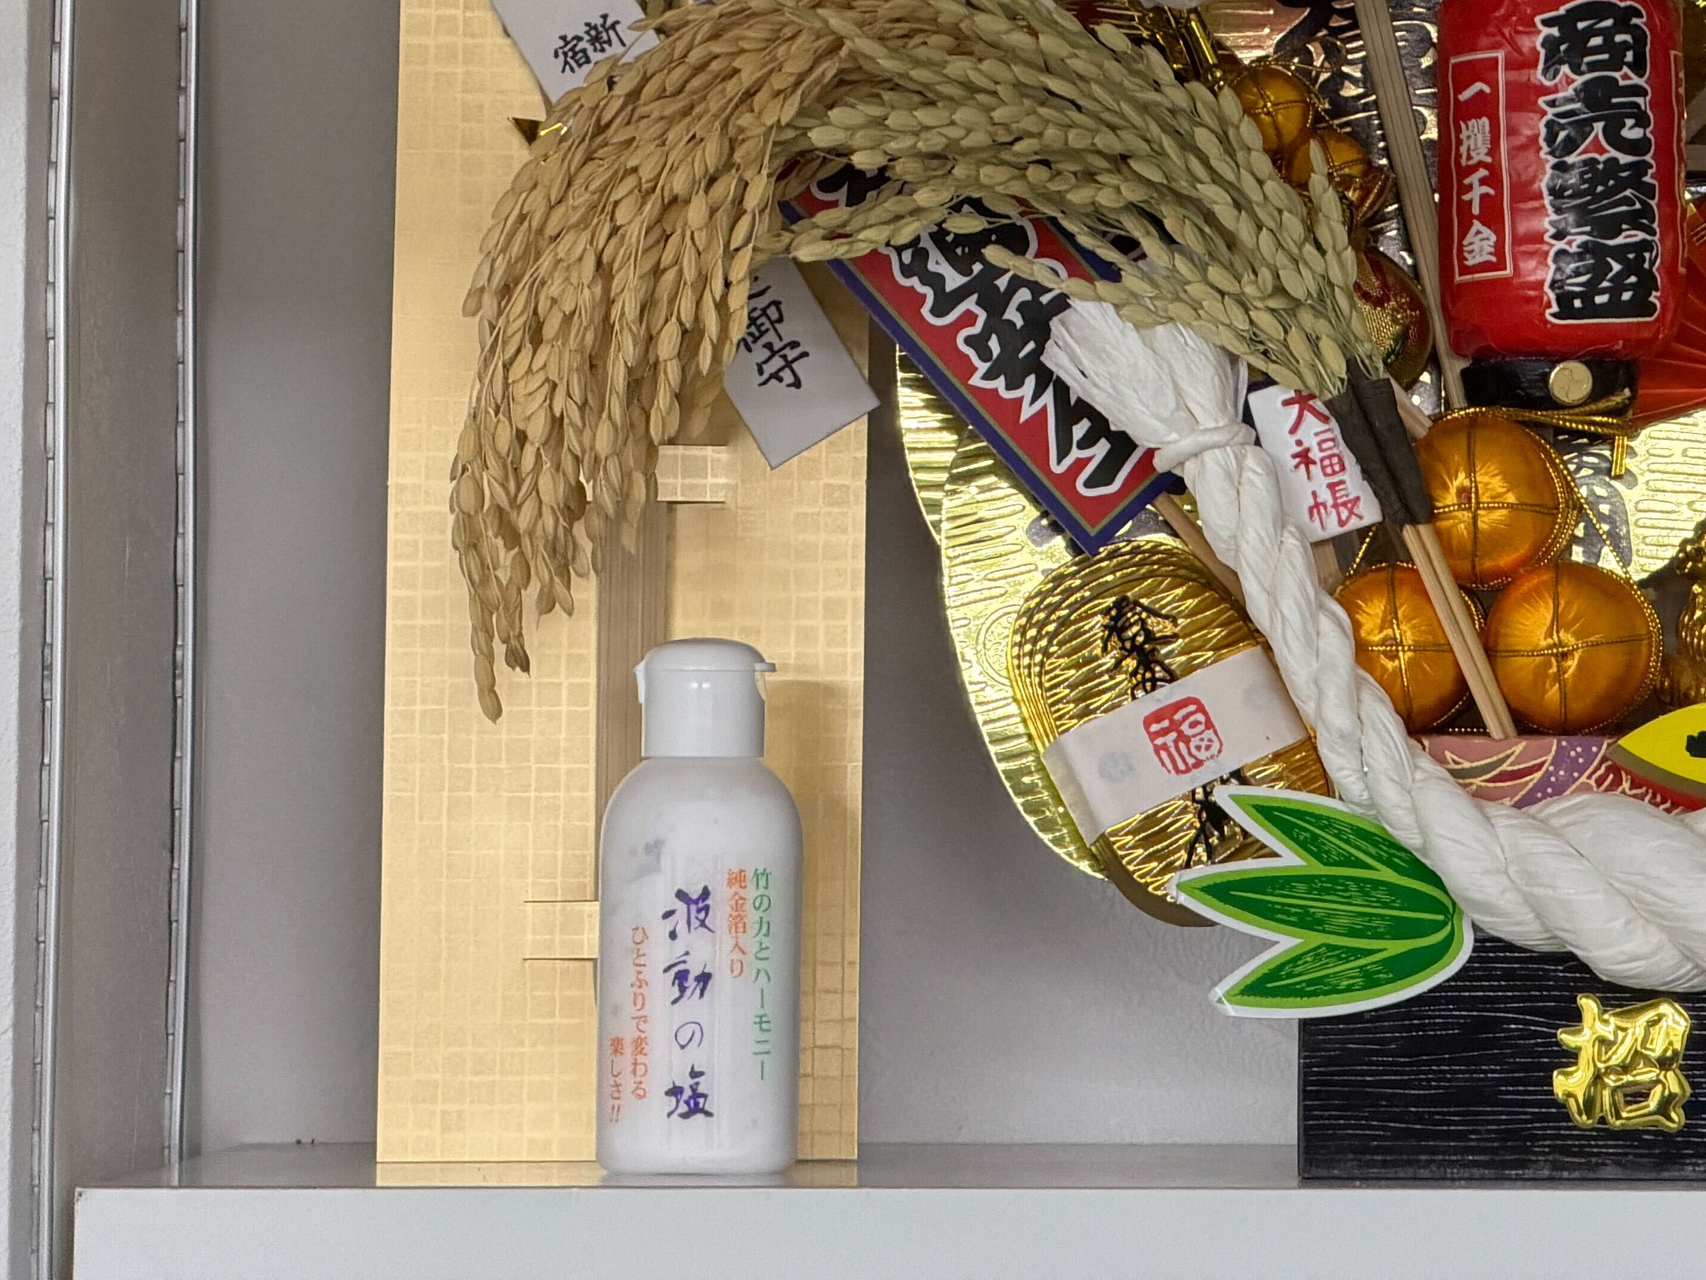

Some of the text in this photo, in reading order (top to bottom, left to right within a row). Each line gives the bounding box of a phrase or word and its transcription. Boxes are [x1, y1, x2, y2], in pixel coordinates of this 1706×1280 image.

[553, 13, 626, 74] 新宿
[1281, 389, 1364, 531] 大福帳
[727, 868, 748, 979] 純金箔入り
[752, 867, 773, 1081] 竹の力とハーモニー
[630, 925, 649, 1101] ひとふりで変わる
[661, 884, 717, 1120] 波動の塩
[1553, 993, 1692, 1133] 招
